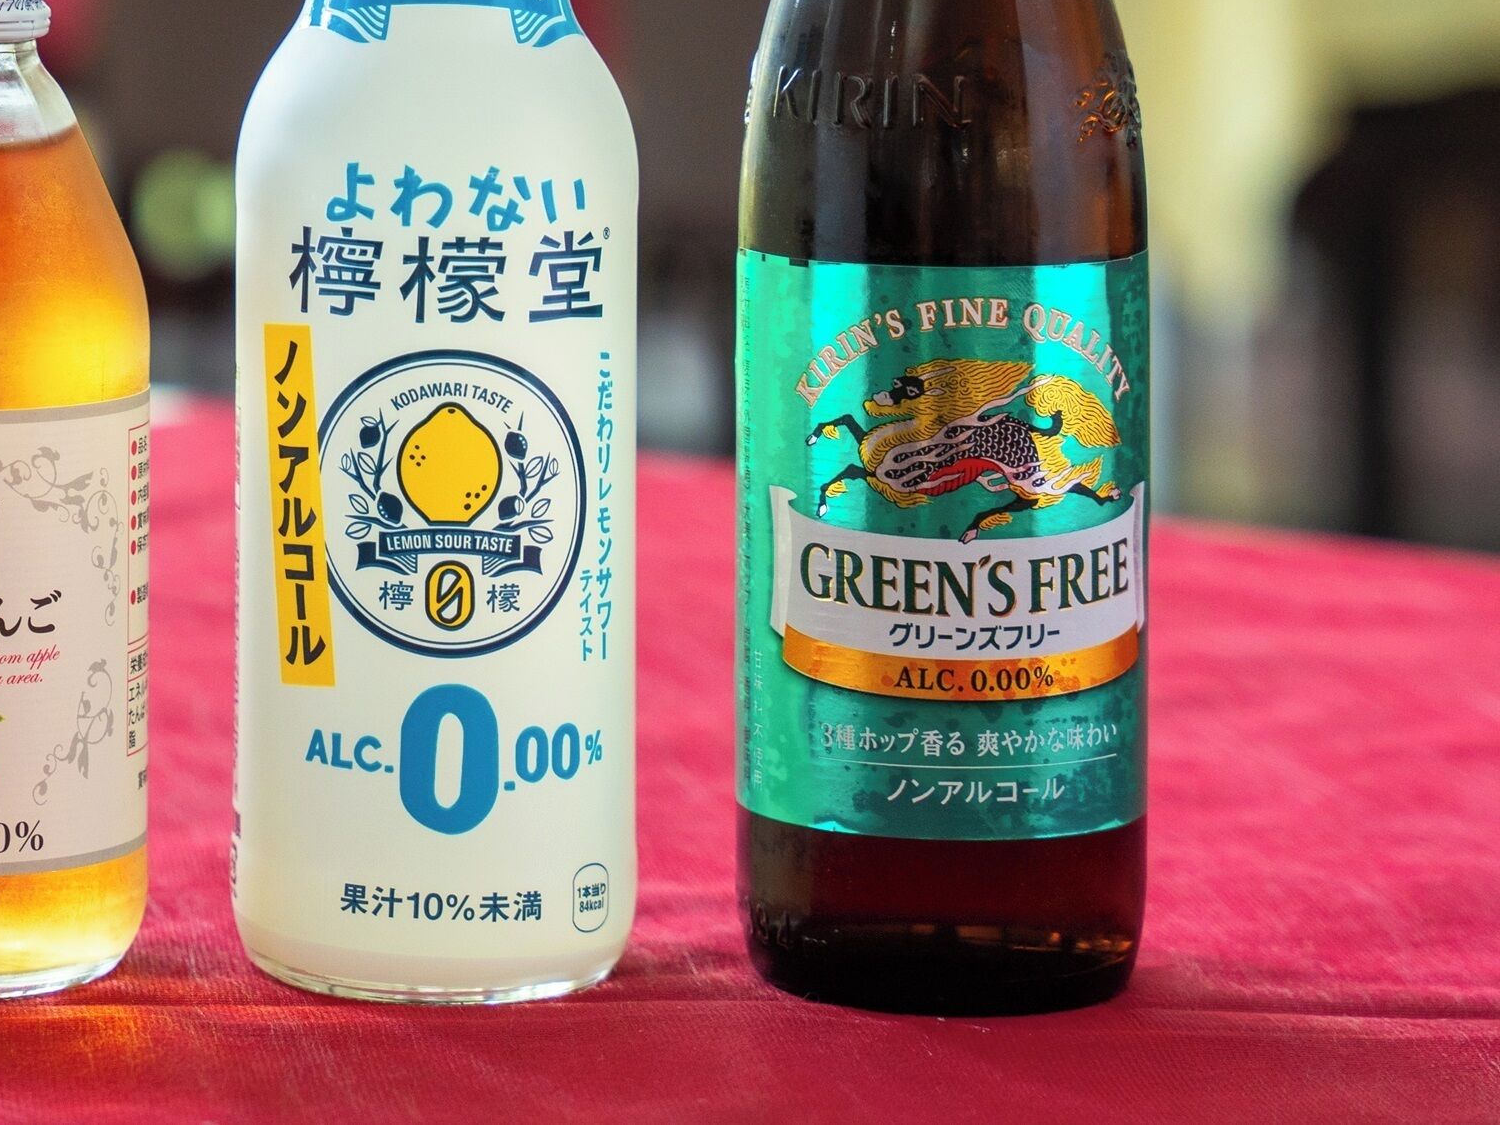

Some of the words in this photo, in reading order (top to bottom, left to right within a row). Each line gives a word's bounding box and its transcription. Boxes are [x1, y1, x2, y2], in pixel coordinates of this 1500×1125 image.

[773, 65, 971, 129] KIRIN
[326, 162, 585, 232] よわない
[289, 226, 602, 324] 檸檬堂
[795, 308, 905, 408] KIRIN'S
[916, 297, 1010, 331] FINE
[1022, 303, 1130, 403] QUALITY
[391, 382, 468, 412] KODAWARI
[472, 384, 513, 414] TASTE
[274, 341, 326, 665] ノンアルコール
[596, 352, 612, 660] こだわりレモンサワー
[387, 535, 432, 551] LEMON
[436, 534, 472, 550] SOUR
[474, 536, 512, 553] TASTE
[800, 542, 1017, 619] GREEN'S
[1028, 537, 1129, 615] FREE
[889, 622, 1060, 651] グリーンズフリー
[26, 644, 60, 670] apple
[6, 671, 43, 684] area.
[894, 666, 963, 692] ALC.
[971, 664, 1054, 692] 0.00%
[305, 729, 394, 773] ALC.
[820, 723, 966, 758] 3種ホップ香る
[977, 722, 1117, 757] 爽やかな味わい
[887, 779, 1065, 805] ノンアルコール
[340, 883, 542, 922] 果汁10%未満
[577, 883, 606, 898] 1本当り
[579, 896, 604, 912] 84kcal
